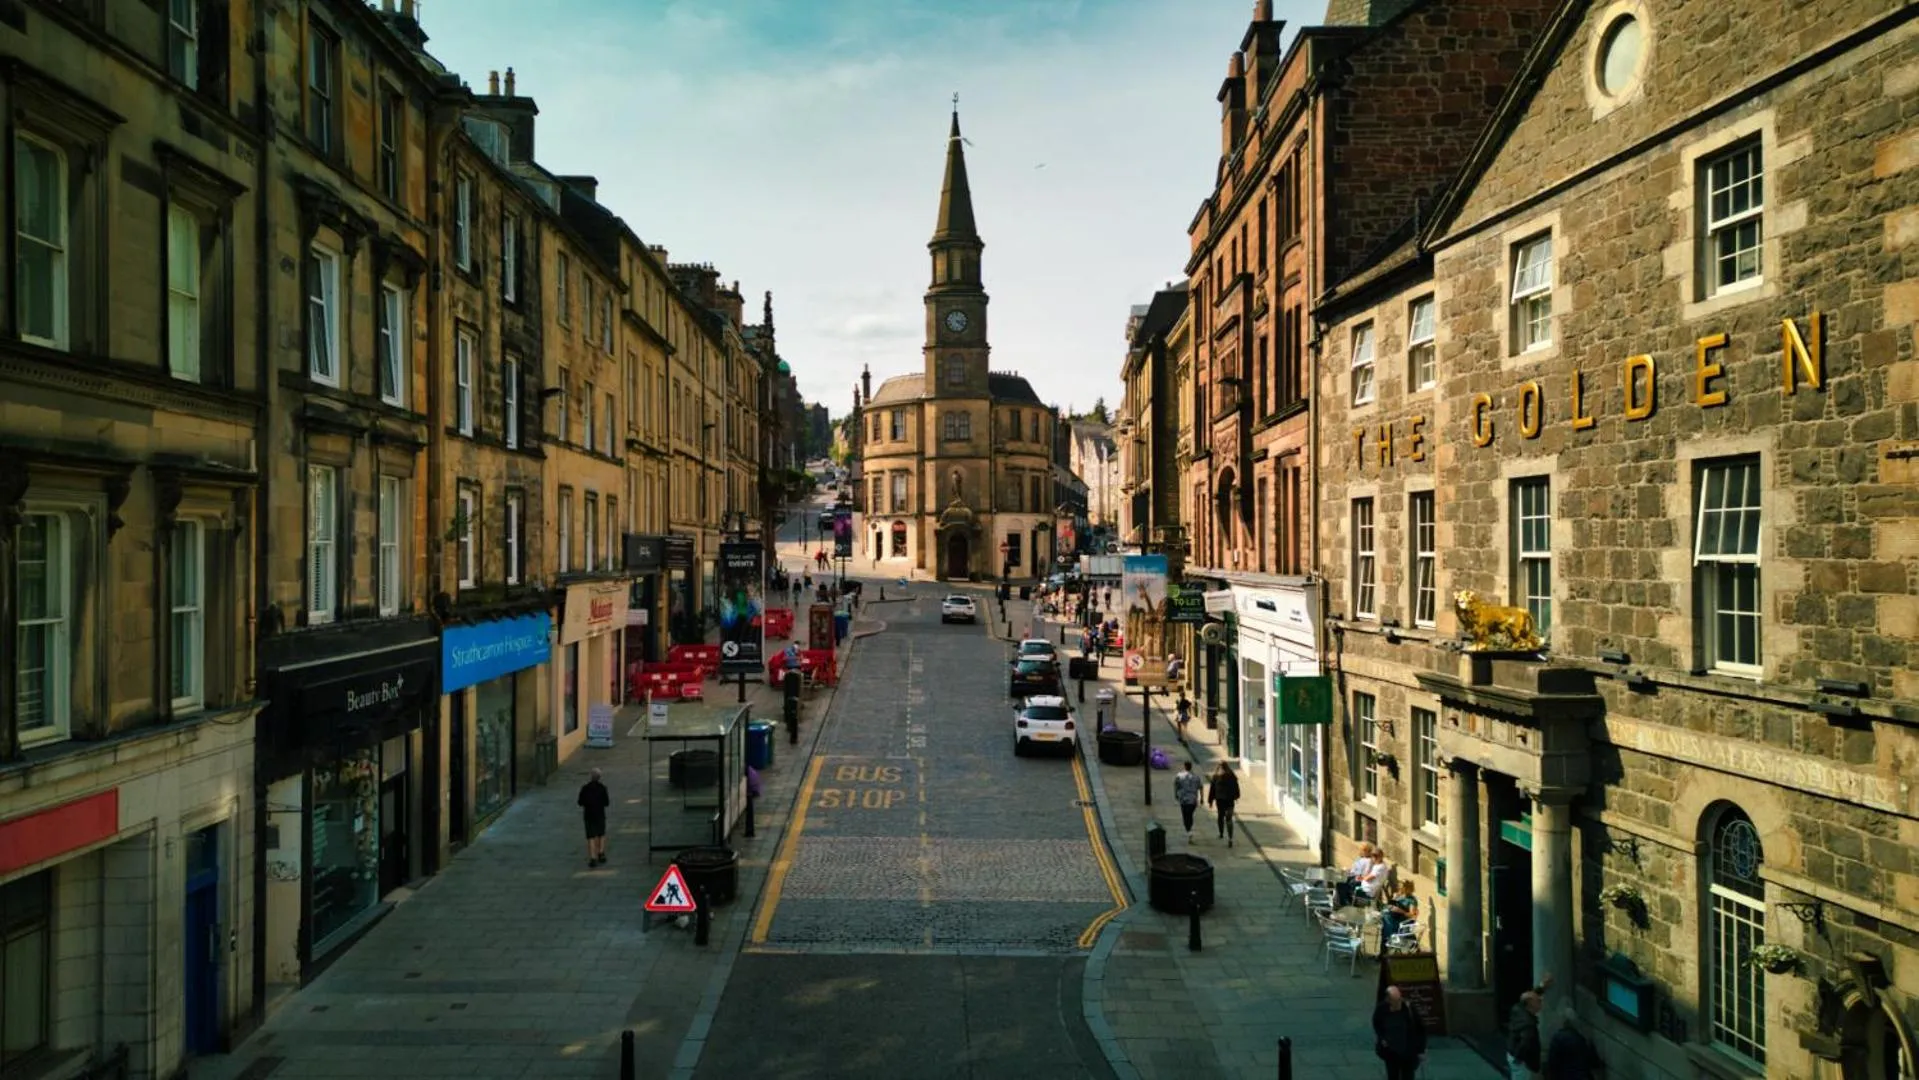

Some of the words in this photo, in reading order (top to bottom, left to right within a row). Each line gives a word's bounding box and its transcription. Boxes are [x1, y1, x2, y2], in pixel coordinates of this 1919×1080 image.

[1352, 416, 1425, 470] THE
[1472, 310, 1822, 448] GOLDEN
[1174, 598, 1185, 606] TO
[1186, 597, 1202, 606] LET
[452, 641, 504, 669] Strathcarron
[505, 635, 533, 656] Hospice
[347, 690, 381, 713] Beauty
[835, 765, 904, 783] BUS
[818, 788, 906, 809] STOP
